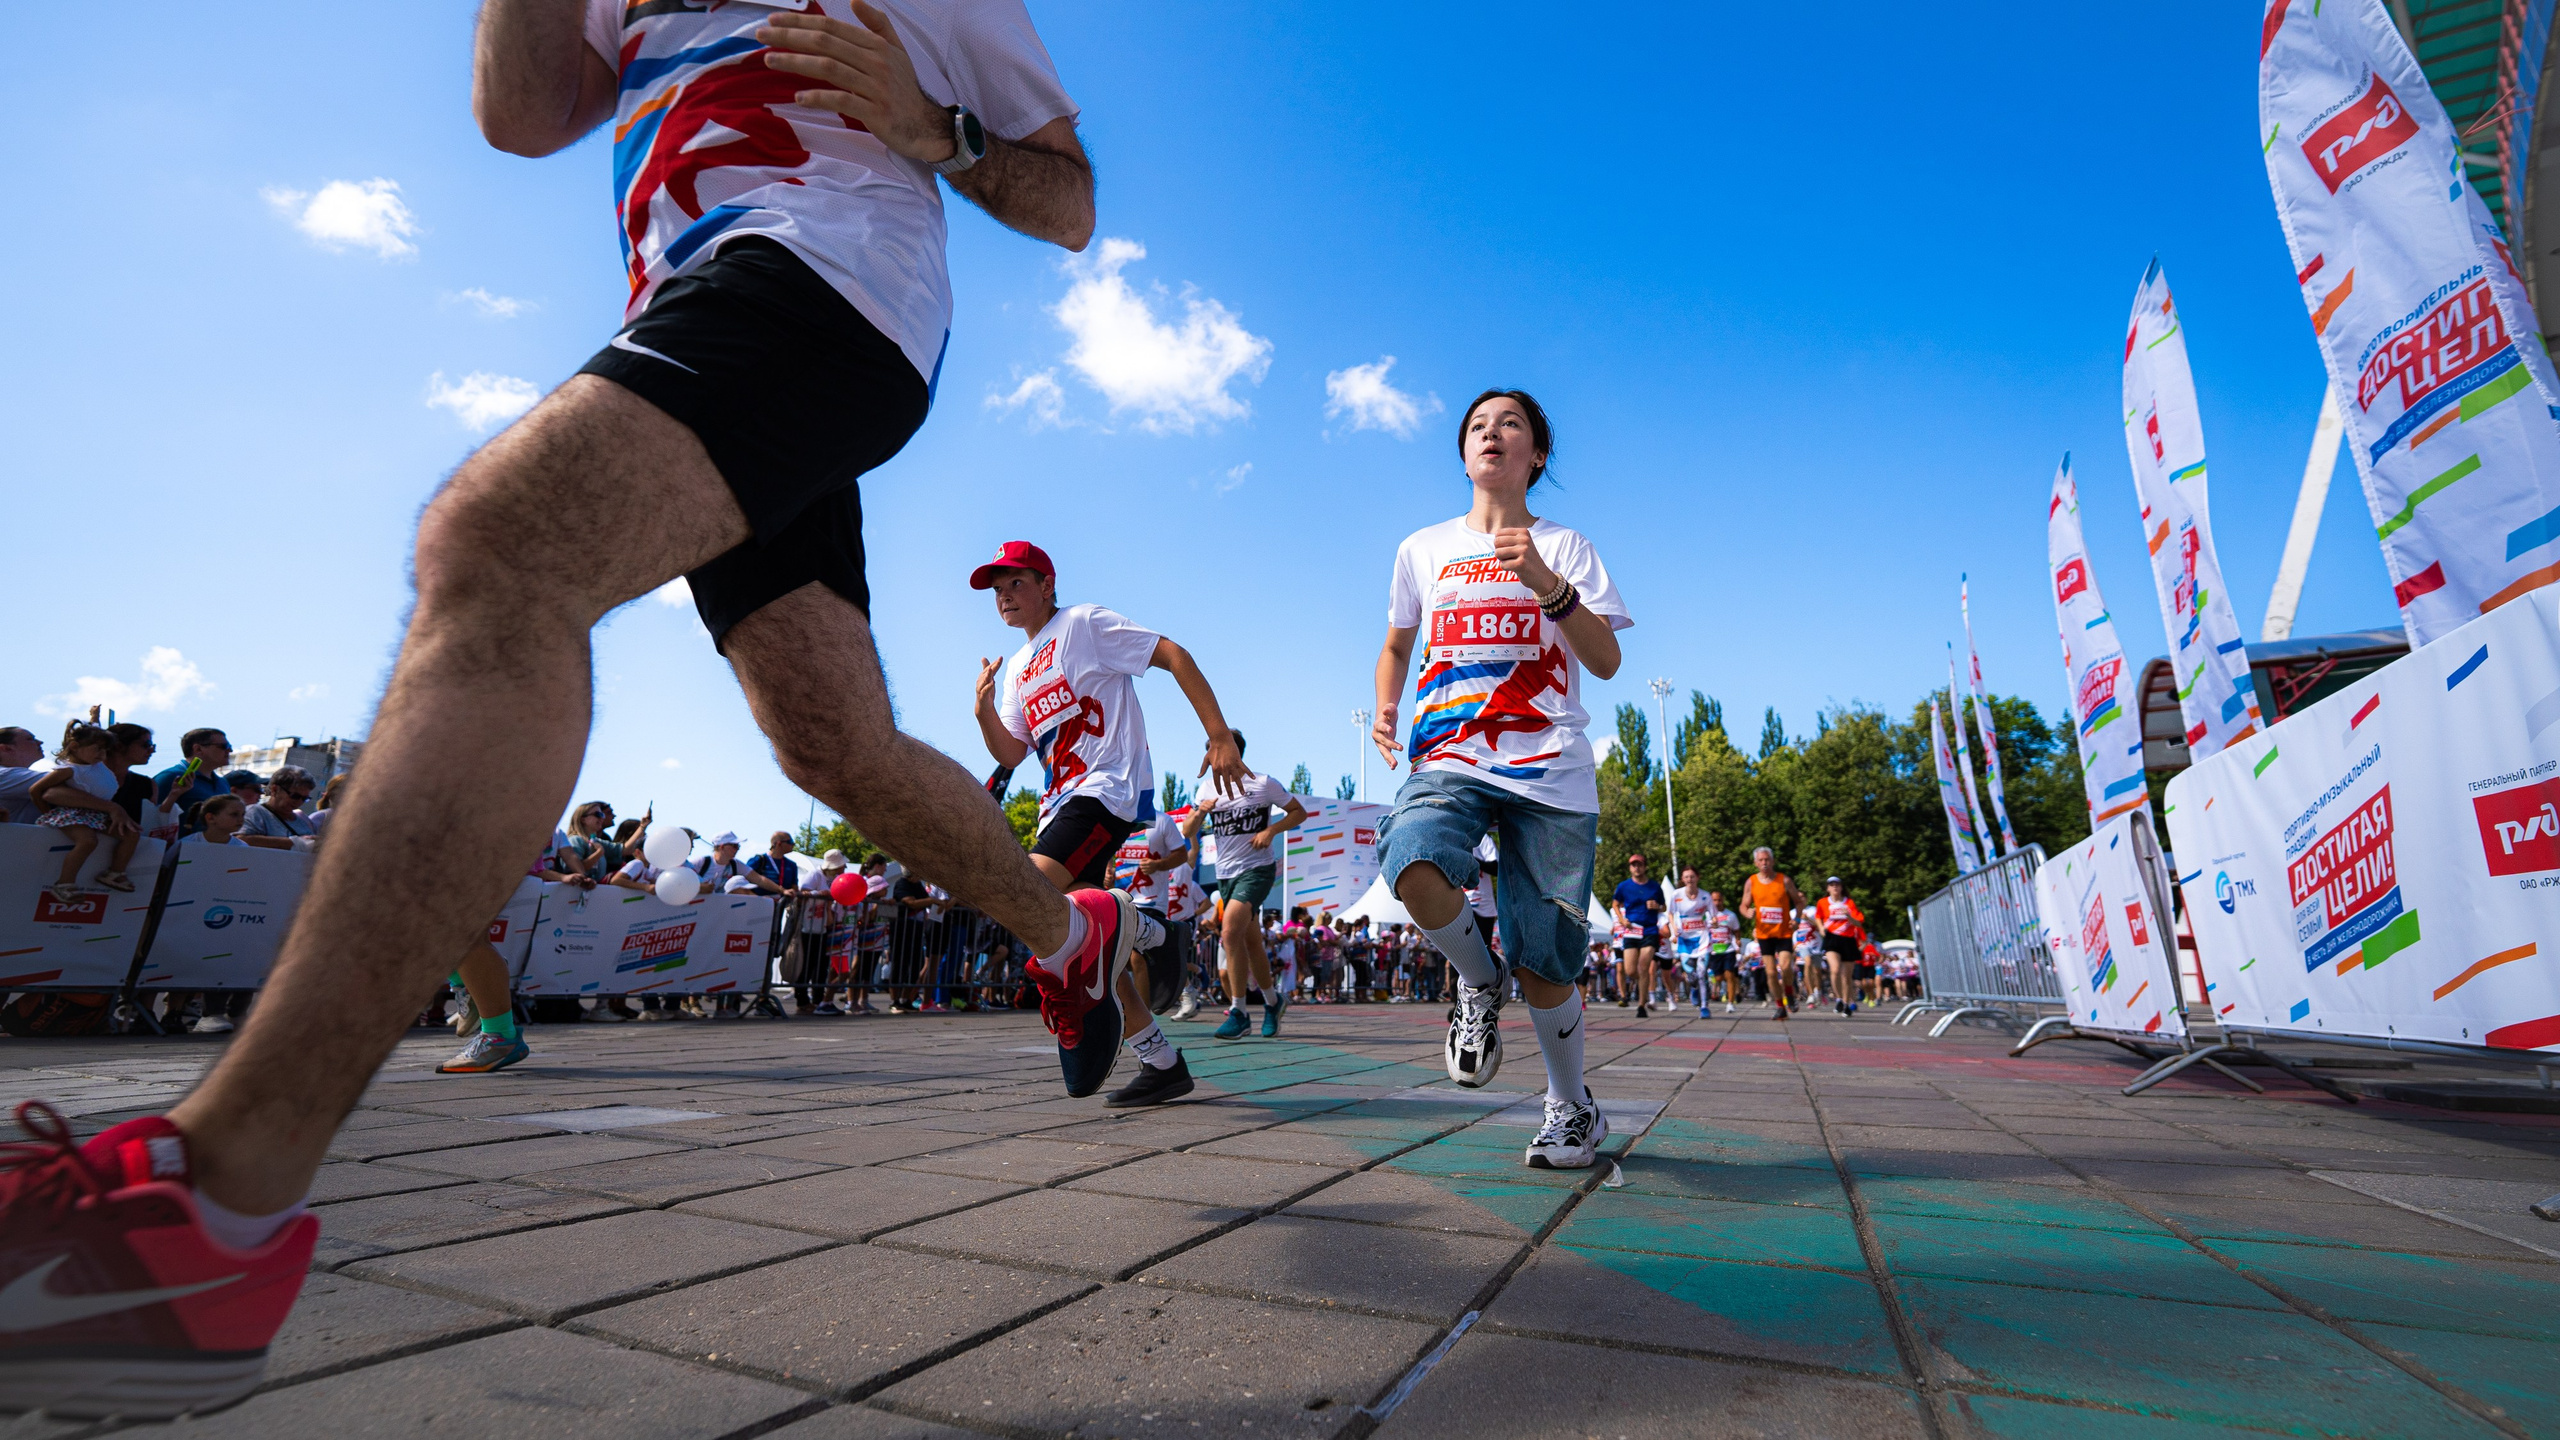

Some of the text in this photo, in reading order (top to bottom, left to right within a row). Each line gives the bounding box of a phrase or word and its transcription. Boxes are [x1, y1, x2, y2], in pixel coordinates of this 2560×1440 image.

[2362, 282, 2496, 408] ДОСТИГ
[2405, 314, 2503, 396] ЦЕЛ
[1443, 559, 1501, 579] ДОСТИ
[1462, 613, 1535, 639] 1867
[1031, 686, 1072, 721] 1886
[2468, 760, 2557, 792] ГЕНЕРАЛЬНЫЙ ПАРТНЕР
[1214, 804, 1259, 825] NEVER
[1125, 849, 1148, 858] 2277
[2294, 796, 2388, 904] ДОСТИГАЯ
[2327, 839, 2393, 917] ЦЕЛИ!
[2519, 879, 2538, 890] ОАО
[625, 924, 692, 950] ДОСТИГАЯ
[645, 937, 687, 956] ЦЕЛИ!
